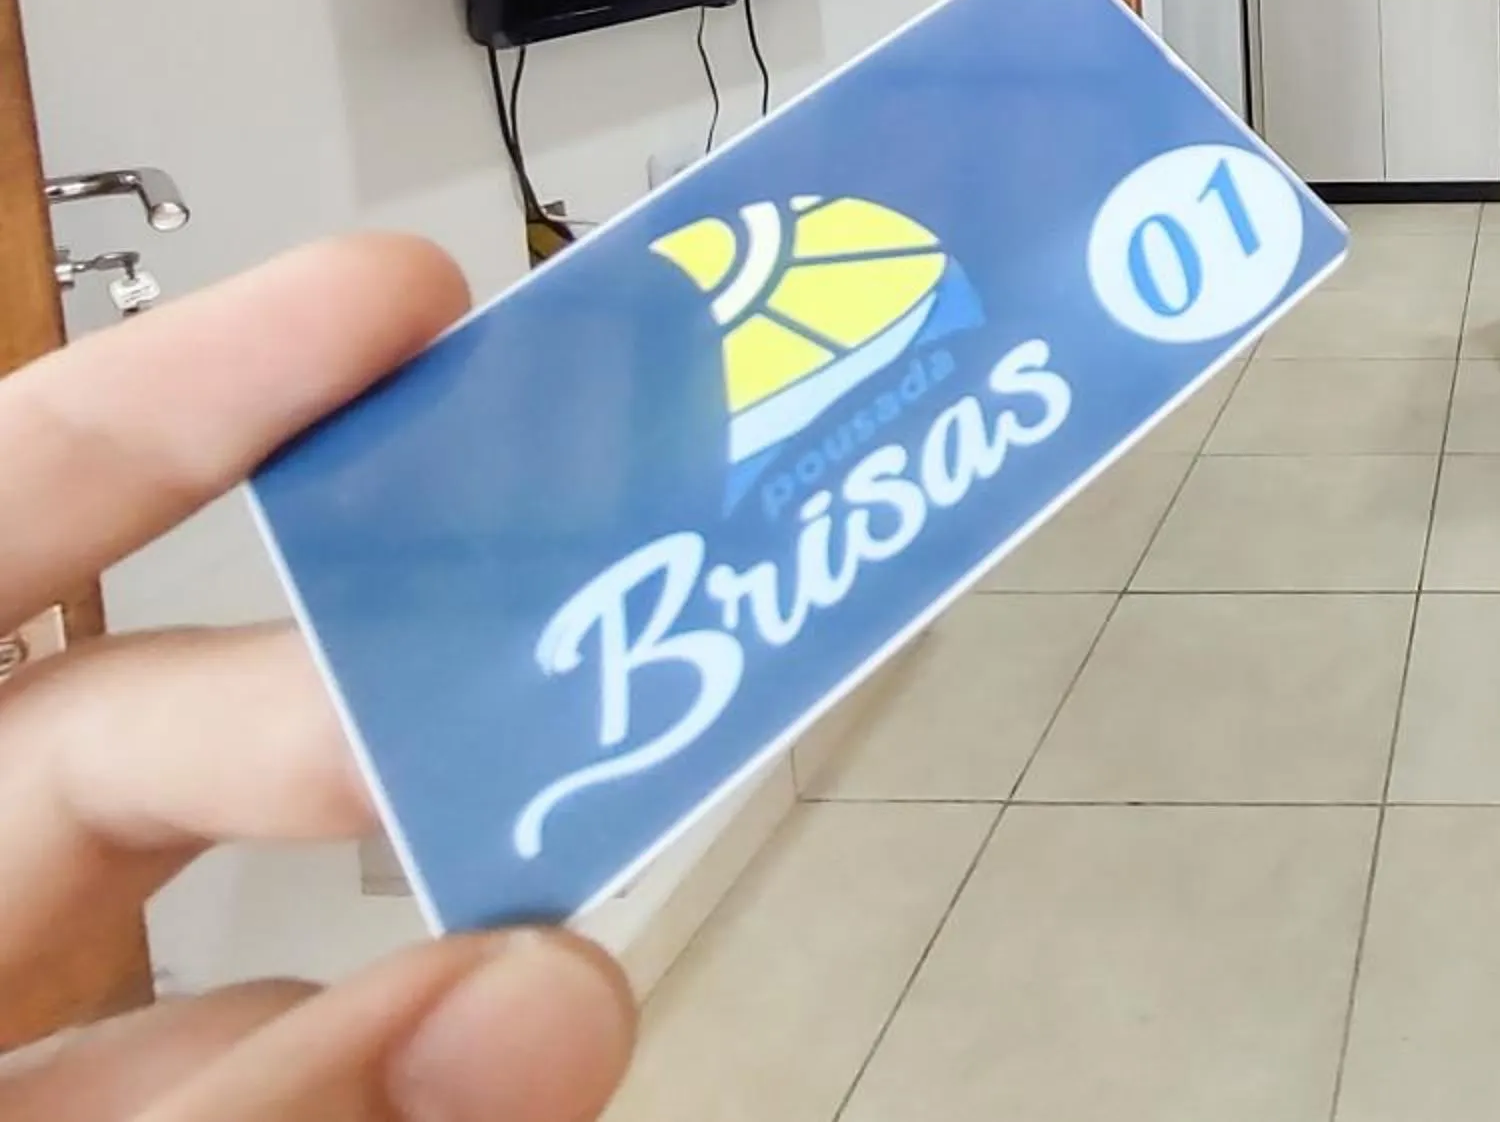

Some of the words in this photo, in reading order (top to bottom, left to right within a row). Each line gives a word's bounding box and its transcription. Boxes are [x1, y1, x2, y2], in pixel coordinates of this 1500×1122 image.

[1127, 157, 1261, 318] 01
[760, 349, 955, 521] pousada
[513, 338, 1073, 860] Brisas
